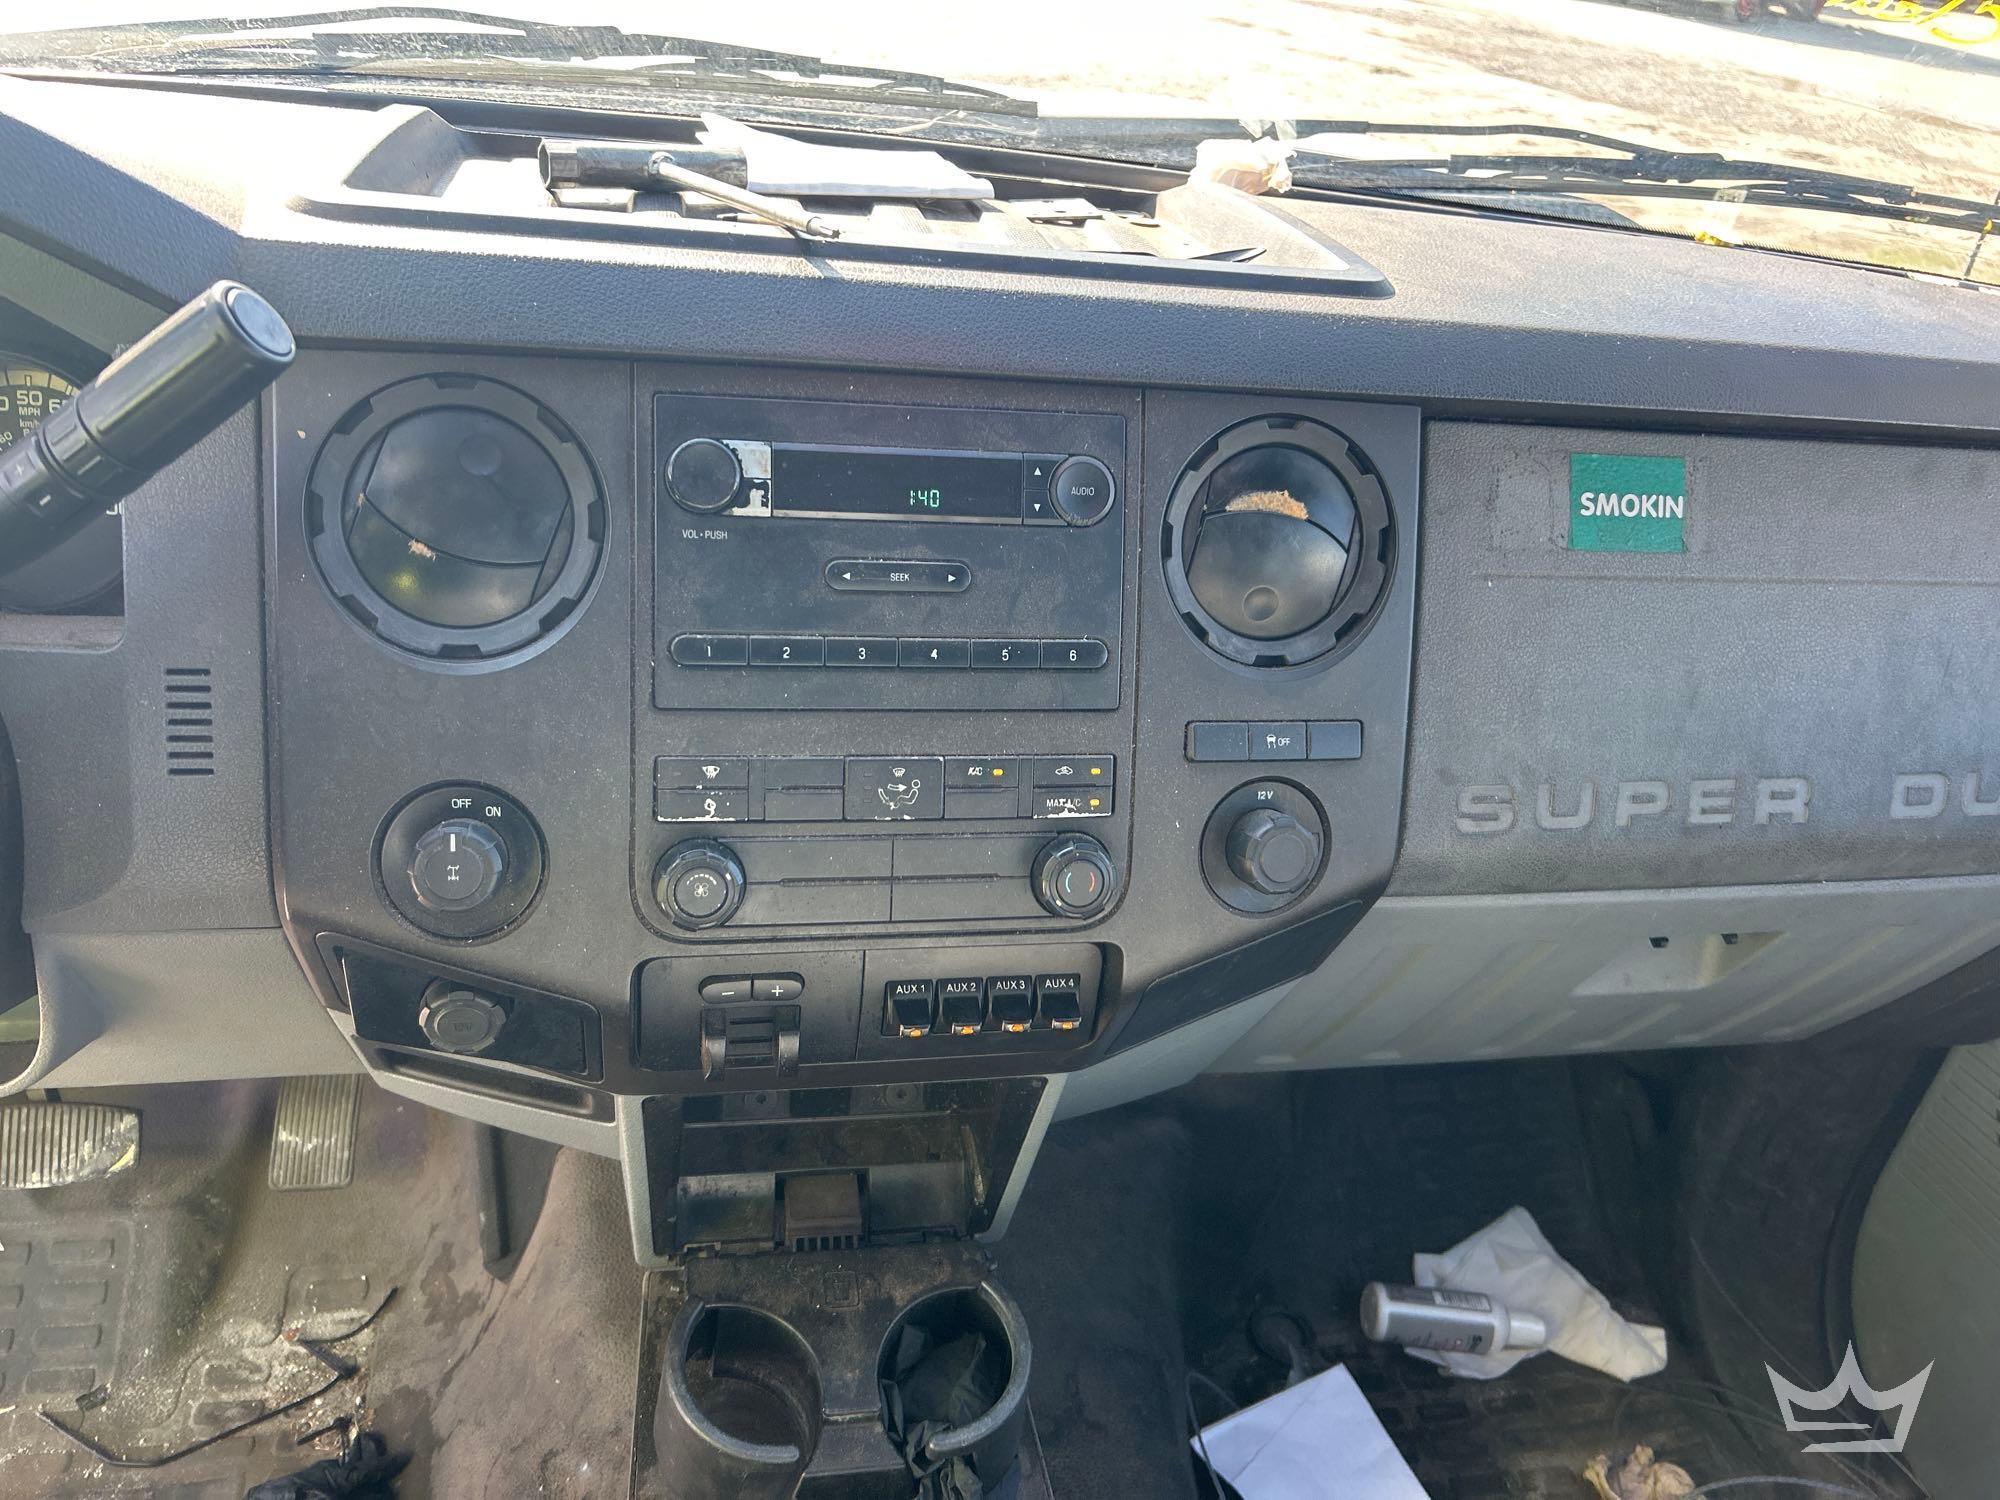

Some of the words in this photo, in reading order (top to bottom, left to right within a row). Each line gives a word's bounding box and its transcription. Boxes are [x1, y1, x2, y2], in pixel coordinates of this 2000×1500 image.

[17, 390, 42, 406] 50
[19, 407, 41, 416] MPH
[1070, 486, 1096, 496] AUDIO
[910, 489, 940, 508] 1:40
[1580, 492, 1684, 518] SMOKIN
[705, 530, 728, 540] PUSH
[890, 572, 910, 582] SEEK
[707, 645, 712, 657] 1
[782, 647, 790, 659] 2
[858, 648, 866, 660] 3
[930, 648, 938, 660] 4
[1002, 649, 1009, 661] 5
[1069, 649, 1077, 661] 6
[1277, 737, 1291, 747] OFF
[1257, 790, 1274, 801] 12V
[451, 798, 472, 809] OFF
[1454, 777, 1811, 834] SUPER
[485, 805, 502, 817] ON
[896, 984, 918, 994] AUX
[920, 983, 926, 993] 1
[946, 983, 968, 993] AUX
[970, 982, 977, 992] 2
[996, 981, 1017, 991] AUX
[1019, 980, 1026, 990] 3
[1045, 978, 1066, 989] AUX
[1068, 978, 1075, 988] 4
